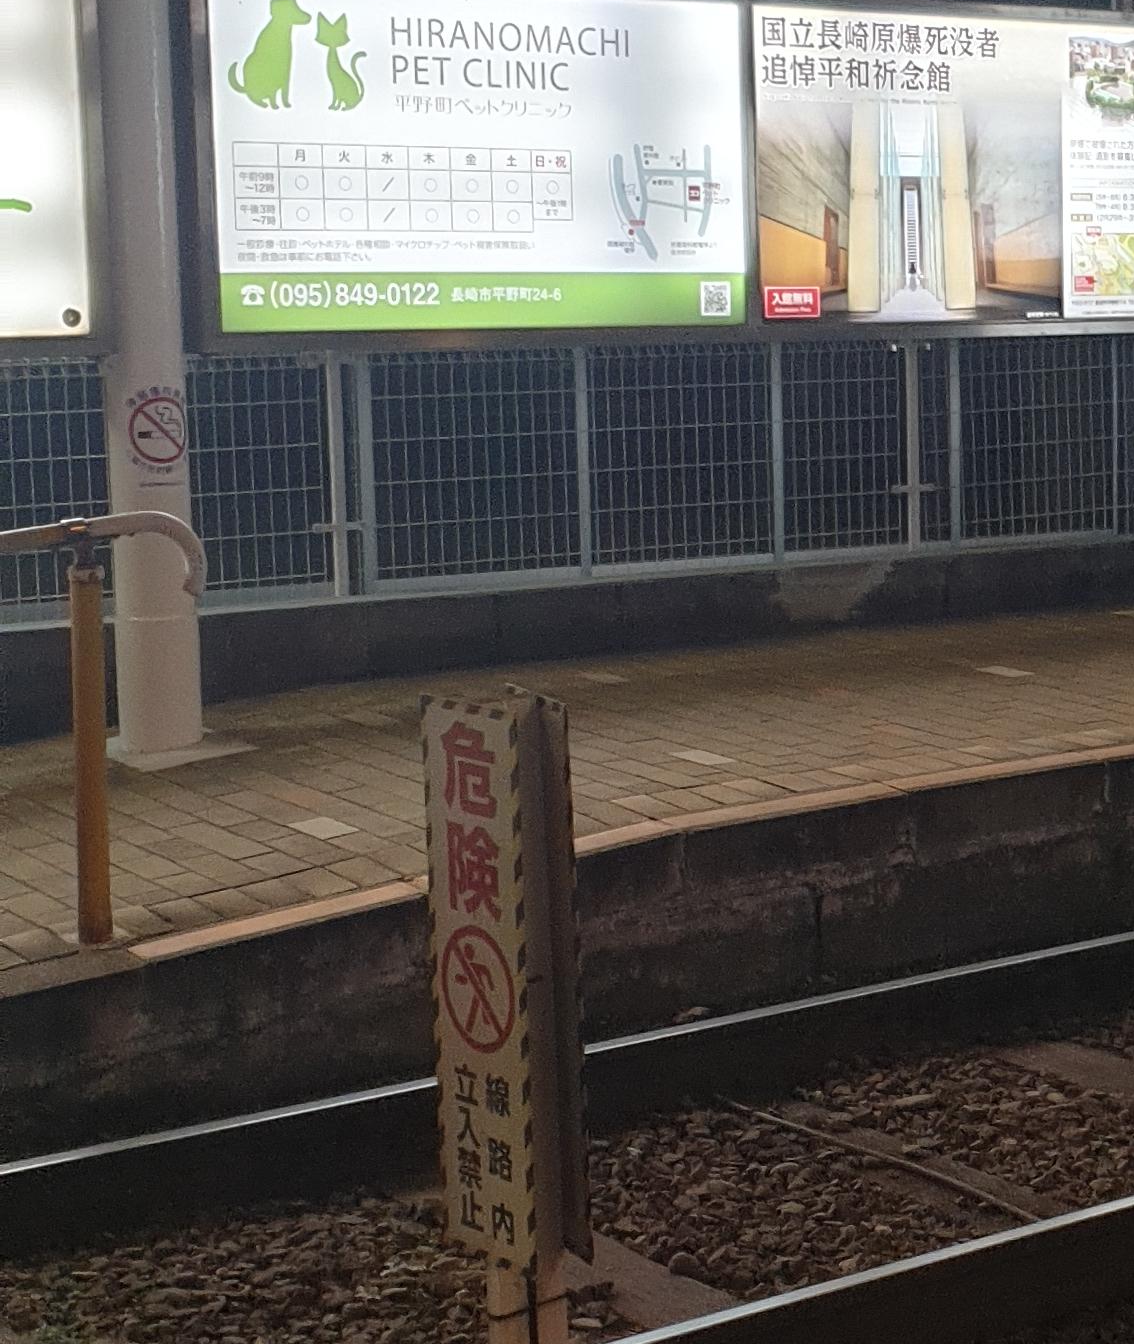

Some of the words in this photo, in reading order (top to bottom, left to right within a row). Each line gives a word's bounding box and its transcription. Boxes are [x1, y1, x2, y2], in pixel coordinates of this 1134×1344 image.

[391, 17, 630, 58] HIRANOMACHI
[762, 16, 1000, 59] 国立長崎原爆死没者
[392, 55, 452, 86] PET
[463, 58, 570, 92] CLINIC
[761, 53, 951, 93] 追悼平和祈念館
[396, 95, 572, 118] 平野町ペットクリニック
[294, 149, 306, 162] 月
[338, 151, 350, 163] 火
[381, 152, 393, 165] 水
[423, 153, 435, 165] 木
[465, 153, 477, 166] 金
[506, 155, 517, 167] 土
[535, 155, 567, 169] 日・祝
[451, 286, 562, 302] 長崎市平野町24-6
[441, 720, 502, 923] 危険
[454, 1063, 485, 1233] 立入禁止
[485, 1072, 516, 1247] 線路内
